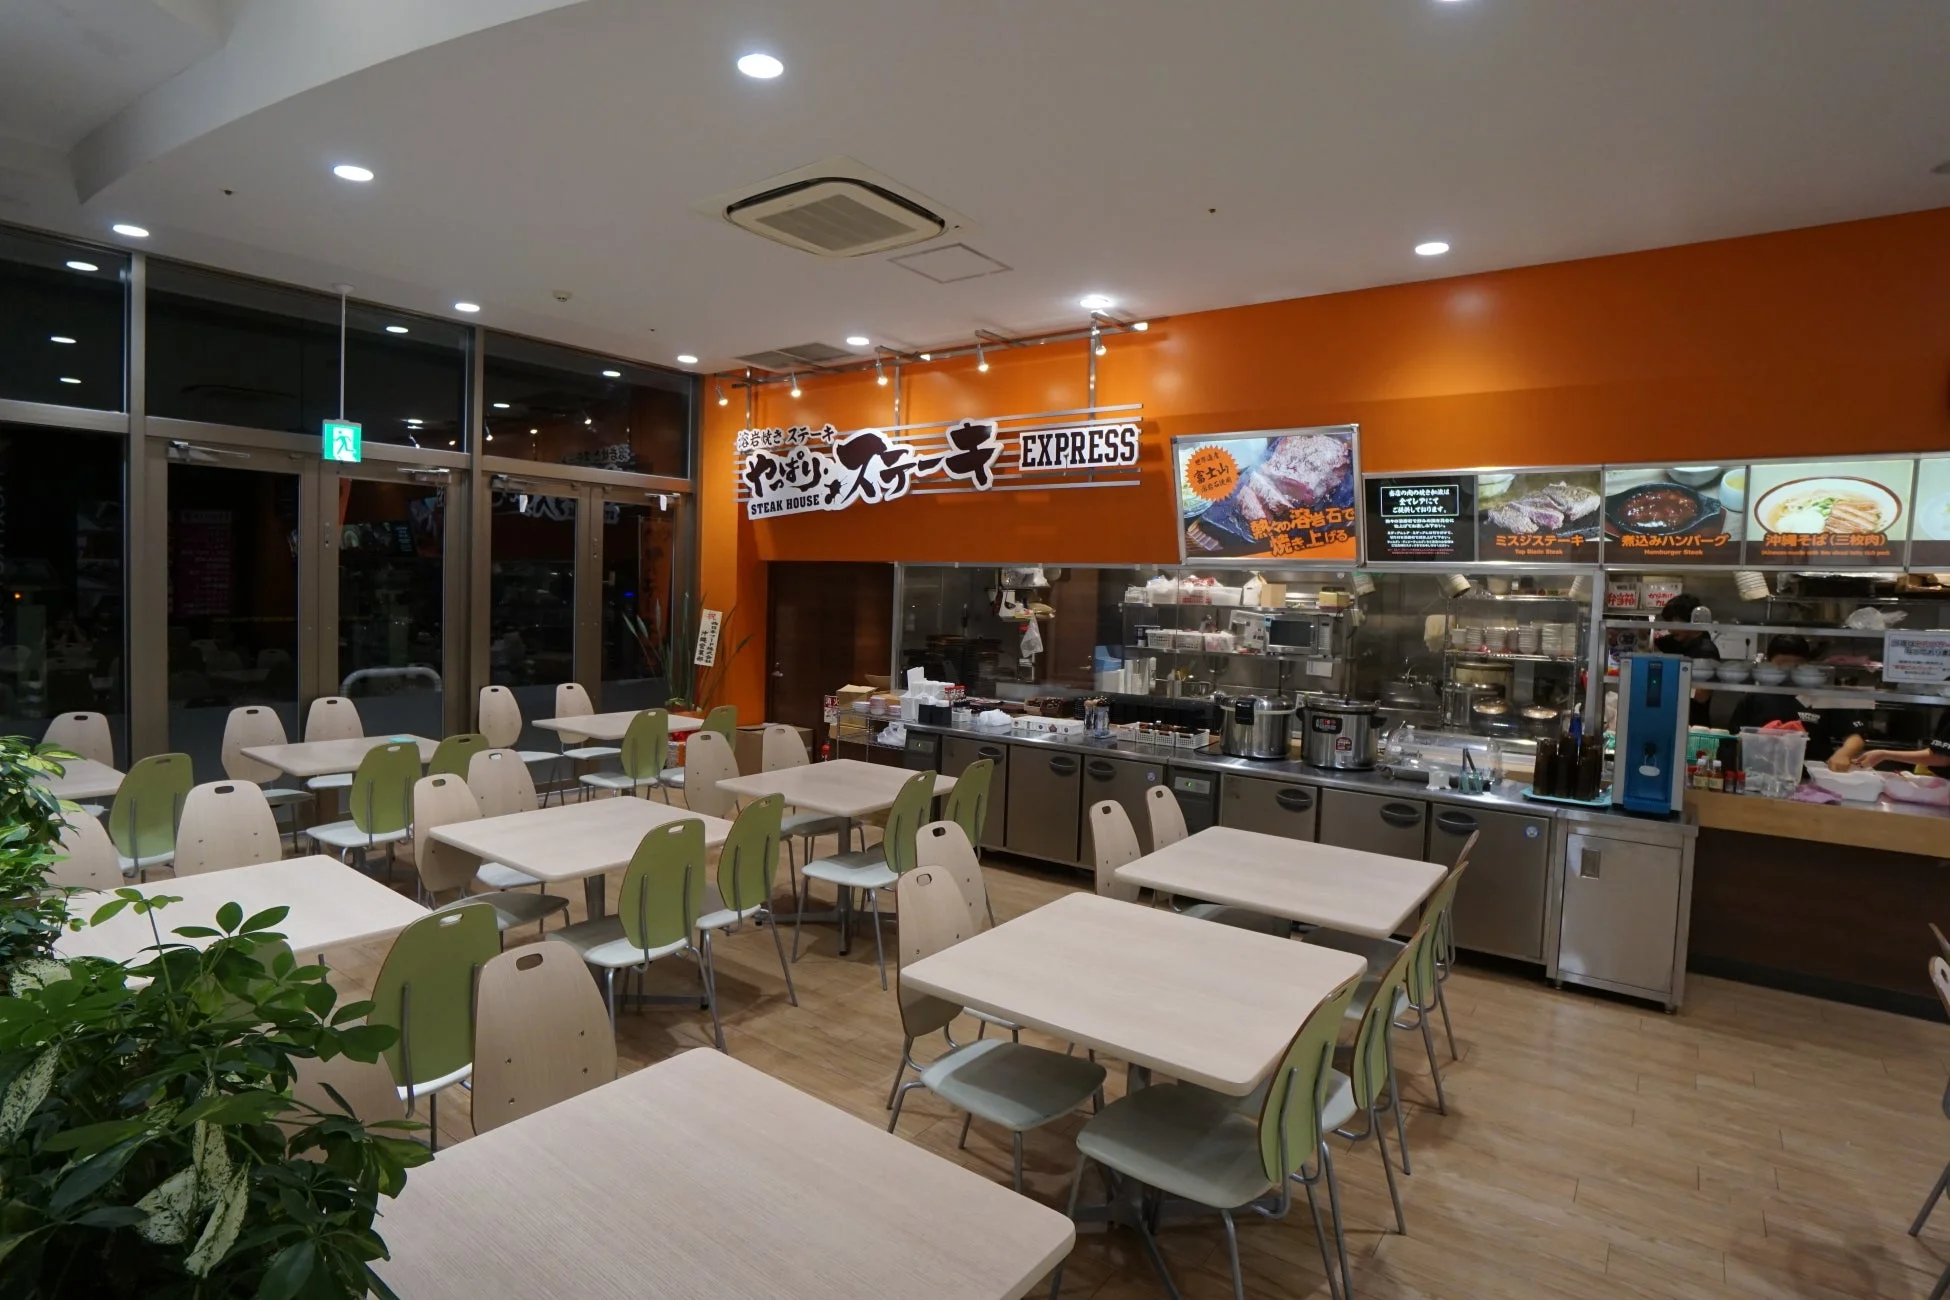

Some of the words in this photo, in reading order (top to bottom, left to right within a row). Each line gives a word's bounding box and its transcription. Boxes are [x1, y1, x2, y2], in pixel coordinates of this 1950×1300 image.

[738, 429, 782, 448] 溶岩焼き
[787, 425, 835, 443] ステーキ
[1021, 427, 1136, 468] EXPRESS
[1193, 462, 1230, 485] 富士山
[751, 498, 783, 515] STEAK
[786, 494, 820, 510] HOUSE
[1399, 497, 1439, 506] 全てレアにて
[1250, 507, 1355, 540] 熱々の溶岩石で
[1269, 529, 1348, 556] 焼き上げる
[1495, 534, 1585, 548] ミスジステーキ
[1621, 534, 1730, 547] 煮込みハンバーグ
